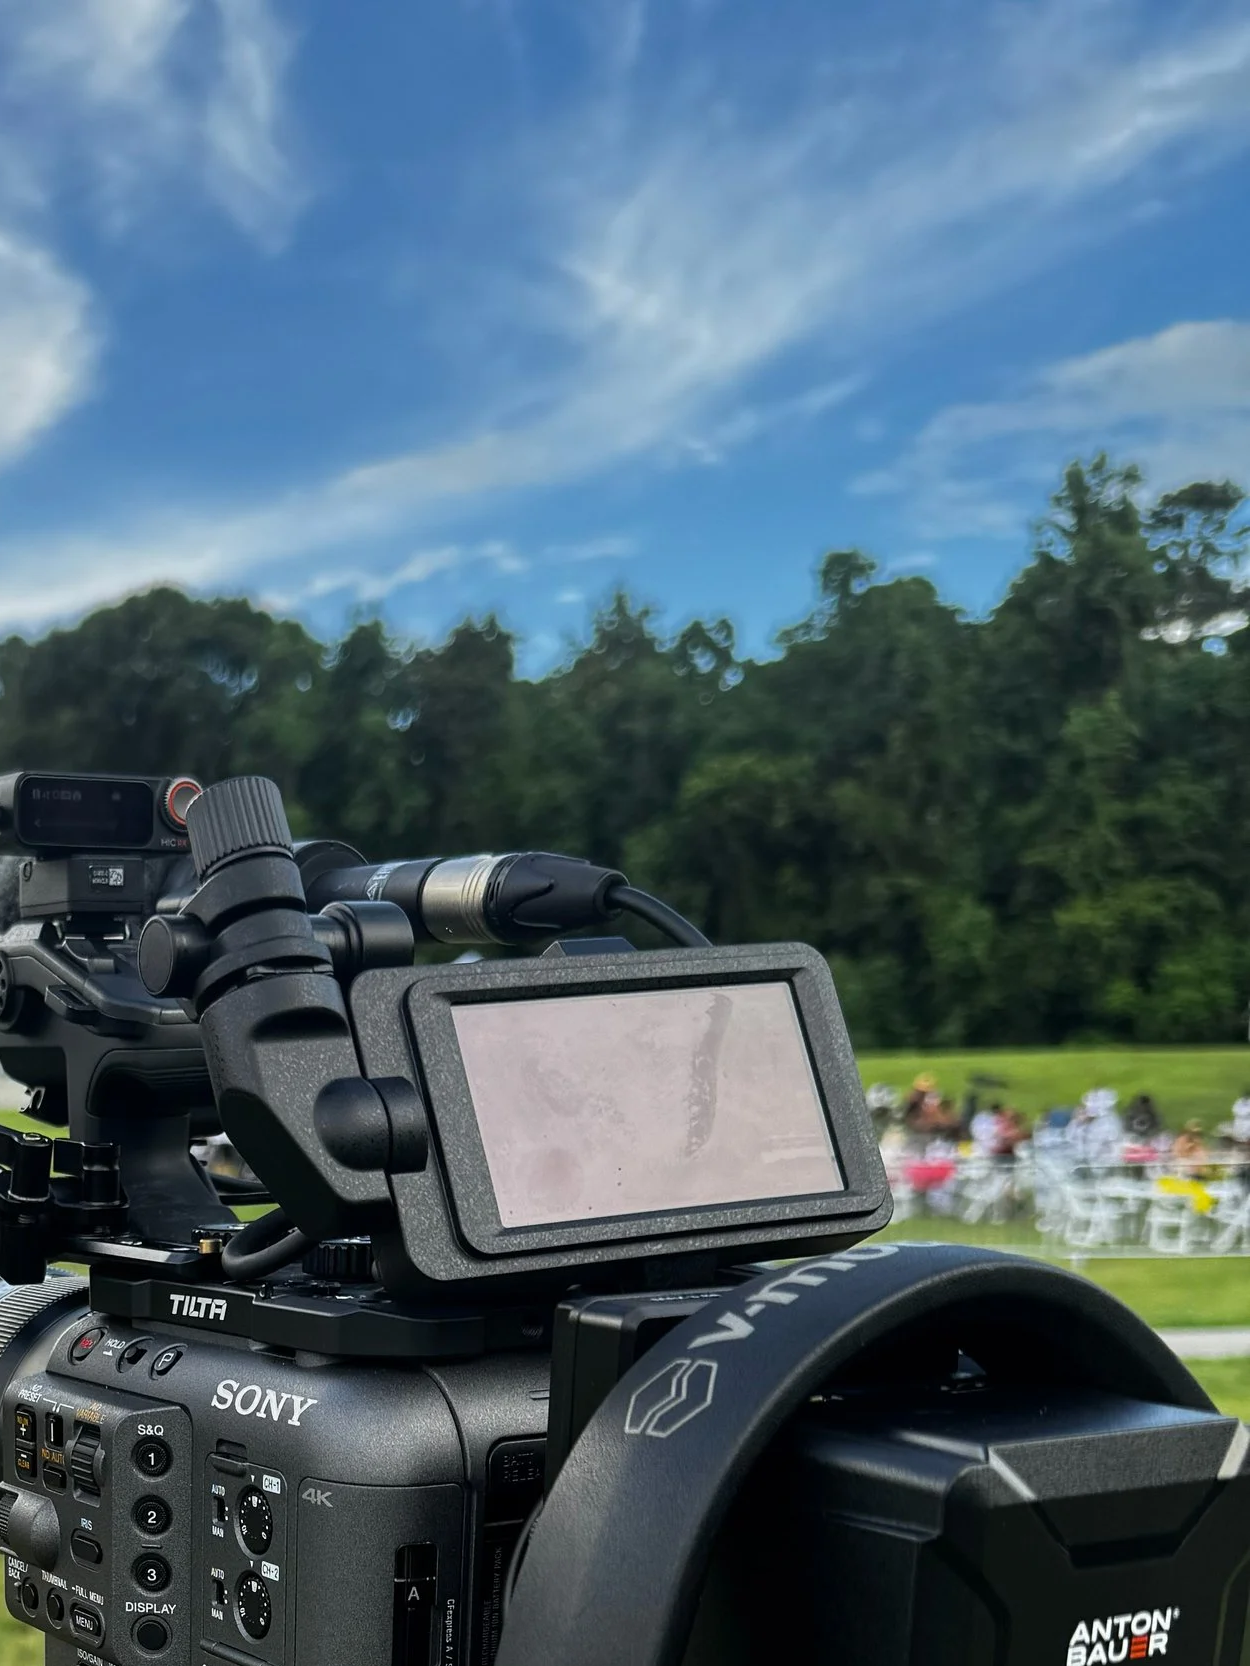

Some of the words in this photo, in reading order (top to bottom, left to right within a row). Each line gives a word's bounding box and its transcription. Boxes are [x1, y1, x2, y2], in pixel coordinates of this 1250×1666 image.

[170, 1294, 227, 1321] TILTA
[105, 1338, 126, 1349] HOLD
[158, 1352, 174, 1367] P
[18, 1389, 42, 1403] PRESET
[211, 1379, 318, 1427] SONY
[137, 1424, 164, 1436] S&Q
[148, 1452, 155, 1466] 1
[211, 1484, 226, 1497] AUTO
[264, 1476, 280, 1492] CH-1
[301, 1487, 333, 1508] 4K
[80, 1517, 93, 1531] IRIS
[147, 1510, 157, 1524] 2
[211, 1525, 224, 1538] MAN
[8, 1567, 21, 1580] BACK
[147, 1568, 157, 1582] 3
[211, 1567, 225, 1580] AUTO
[89, 1590, 104, 1606] MENU
[408, 1586, 420, 1601] A
[125, 1601, 177, 1615] DISPLAY
[211, 1607, 224, 1620] MAN
[75, 1614, 94, 1631] MENU
[1069, 1606, 1172, 1647] ANTON
